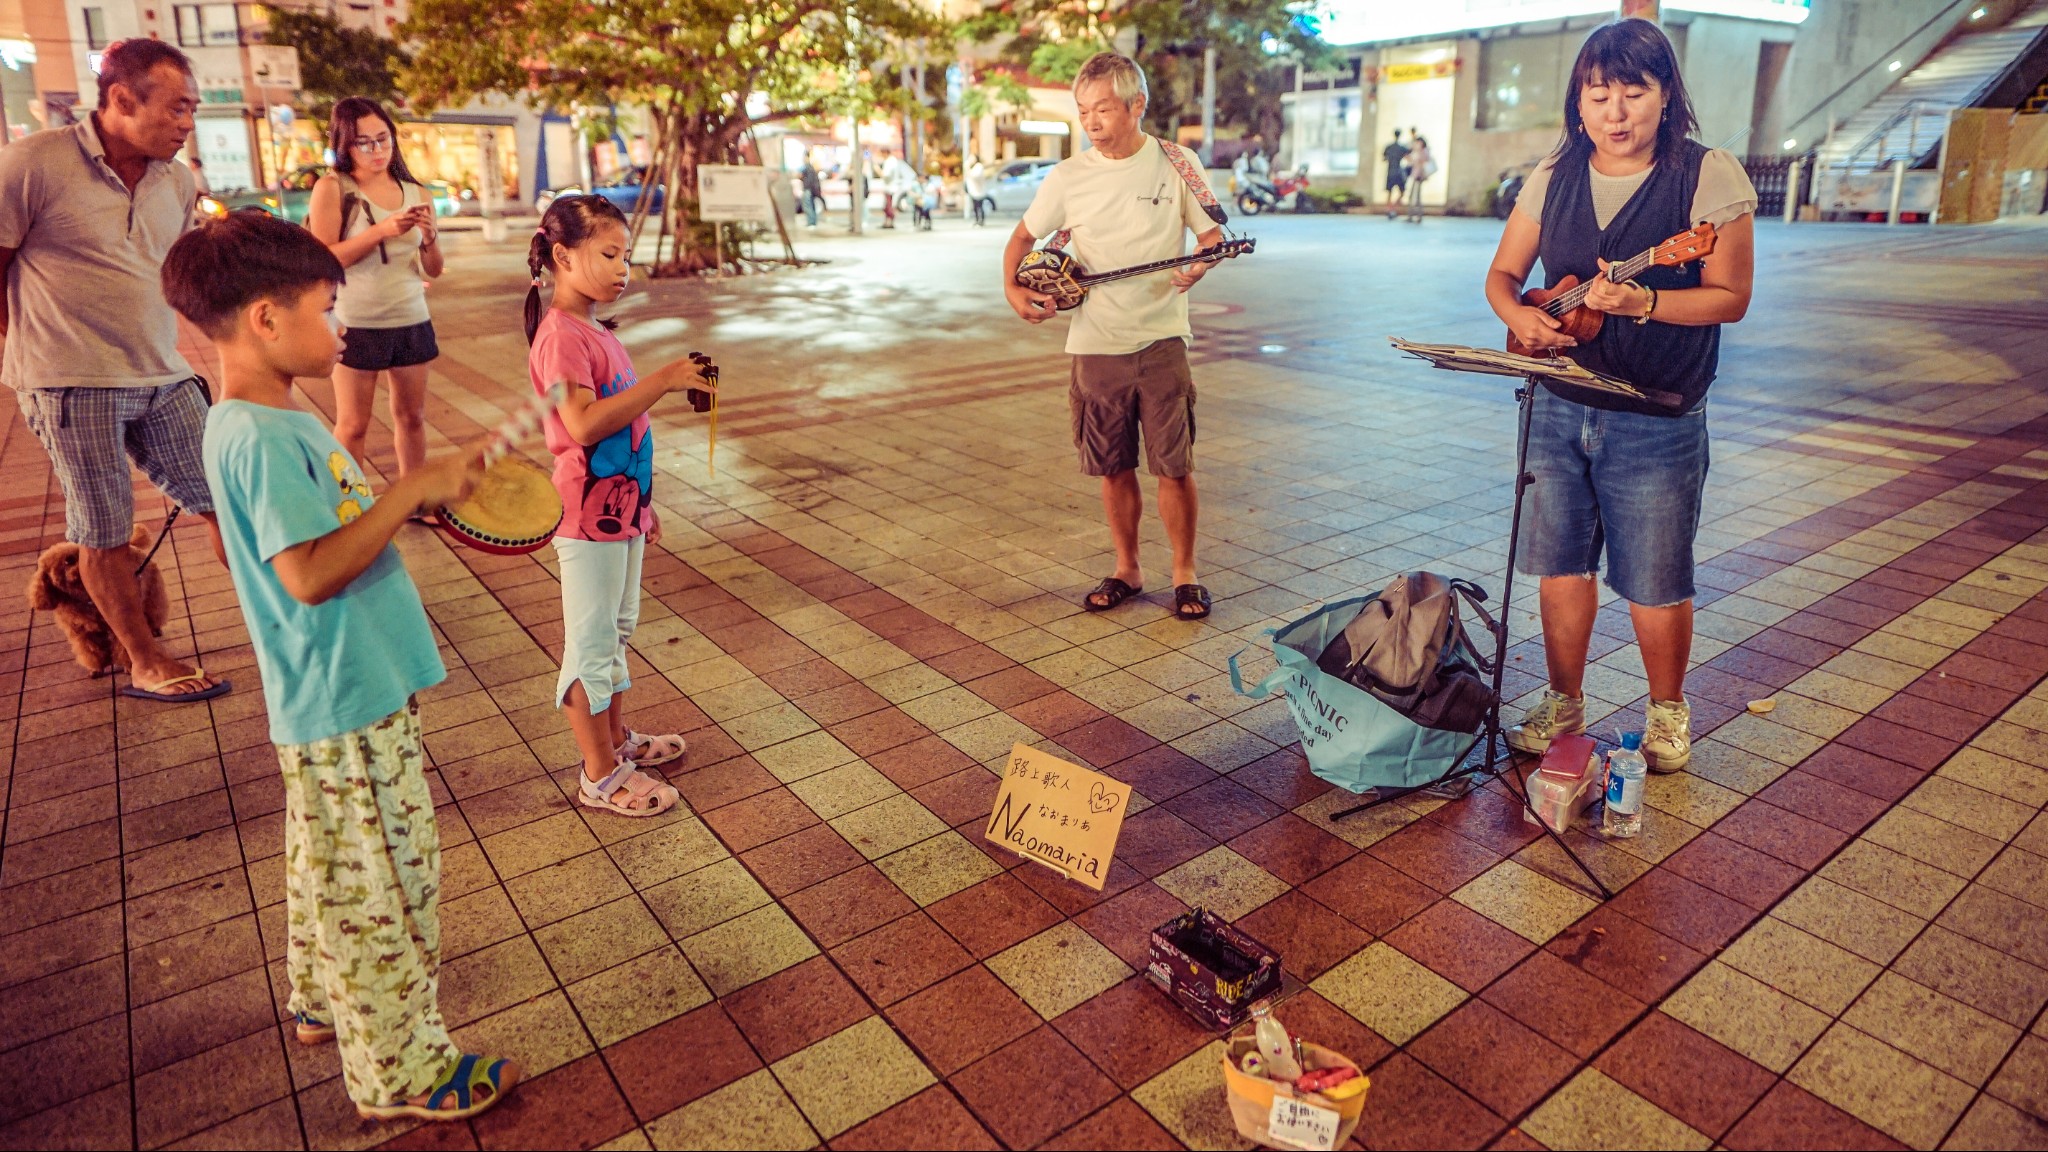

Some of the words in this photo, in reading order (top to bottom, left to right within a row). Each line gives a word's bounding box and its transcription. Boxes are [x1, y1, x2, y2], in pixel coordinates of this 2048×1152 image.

[1300, 674, 1348, 733] PICNIC
[1301, 708, 1312, 728] fine
[1315, 725, 1333, 742] day
[1010, 758, 1070, 790] 路上歌人
[1038, 803, 1091, 832] なおまりあ
[988, 792, 1099, 879] Naomaria
